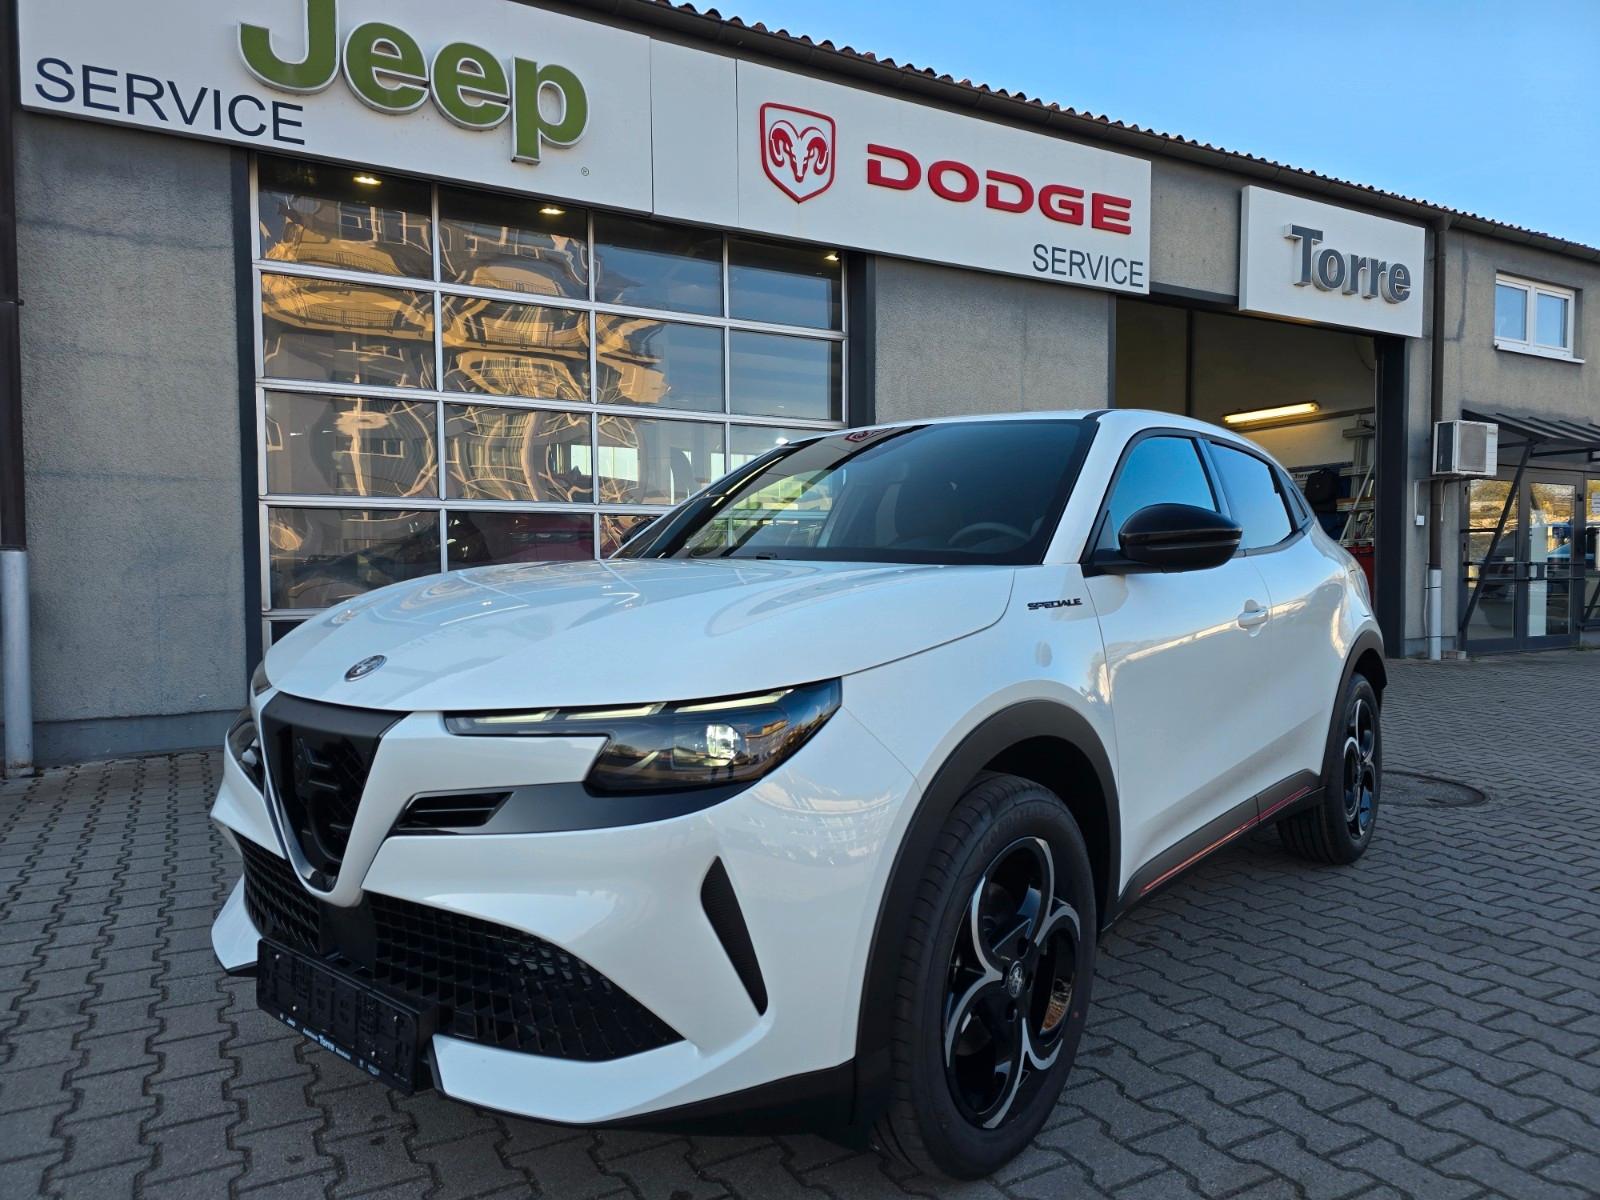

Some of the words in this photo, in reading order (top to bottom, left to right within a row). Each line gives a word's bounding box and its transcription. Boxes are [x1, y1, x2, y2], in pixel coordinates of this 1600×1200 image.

[35, 57, 305, 145] SERVICE
[237, 0, 590, 164] Jeep
[867, 143, 1132, 235] DODGE
[1031, 243, 1144, 288] SERVICE
[1284, 223, 1411, 304] Torre
[1027, 598, 1083, 611] SPECIALE
